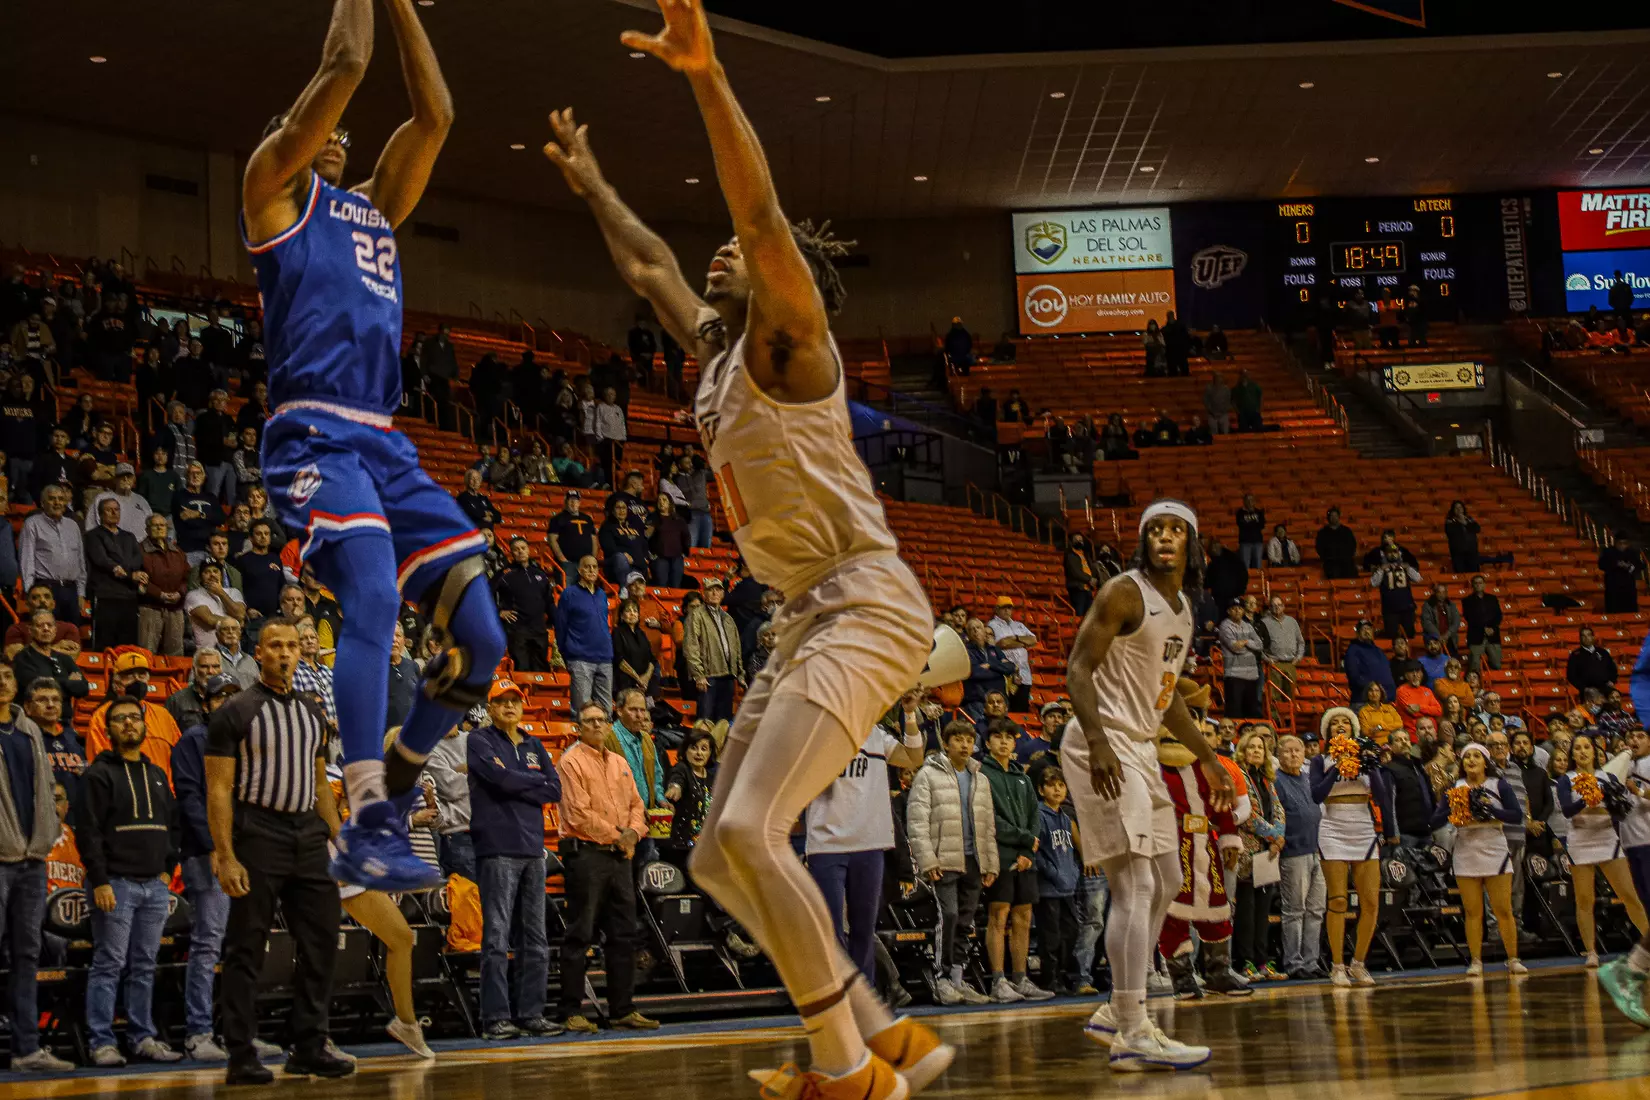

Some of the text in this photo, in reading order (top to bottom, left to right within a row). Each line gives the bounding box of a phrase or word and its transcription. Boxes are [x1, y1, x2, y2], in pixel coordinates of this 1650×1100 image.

[1278, 204, 1314, 217] MINERS
[1070, 216, 1162, 233] LAS PALMAS
[1378, 221, 1414, 233] PERIOD
[1440, 216, 1454, 238] 0
[1606, 208, 1650, 230] FIR
[1295, 221, 1310, 244] 0
[1086, 235, 1147, 252] DEL SOL
[351, 230, 398, 283] 22
[1072, 253, 1163, 265] HEALTHCARE
[1289, 257, 1317, 268] BONUS
[1344, 245, 1400, 269] 18:49
[1420, 252, 1447, 263] BONUS
[1191, 246, 1247, 289] UTEP
[1424, 267, 1456, 281] FOULS
[1284, 273, 1316, 287] FOULS
[1340, 277, 1362, 289] POSS
[1377, 276, 1398, 287] POSS
[1069, 292, 1170, 308] HOY FAMILY AUTO
[1387, 571, 1408, 591] 13
[1154, 671, 1176, 710] 2
